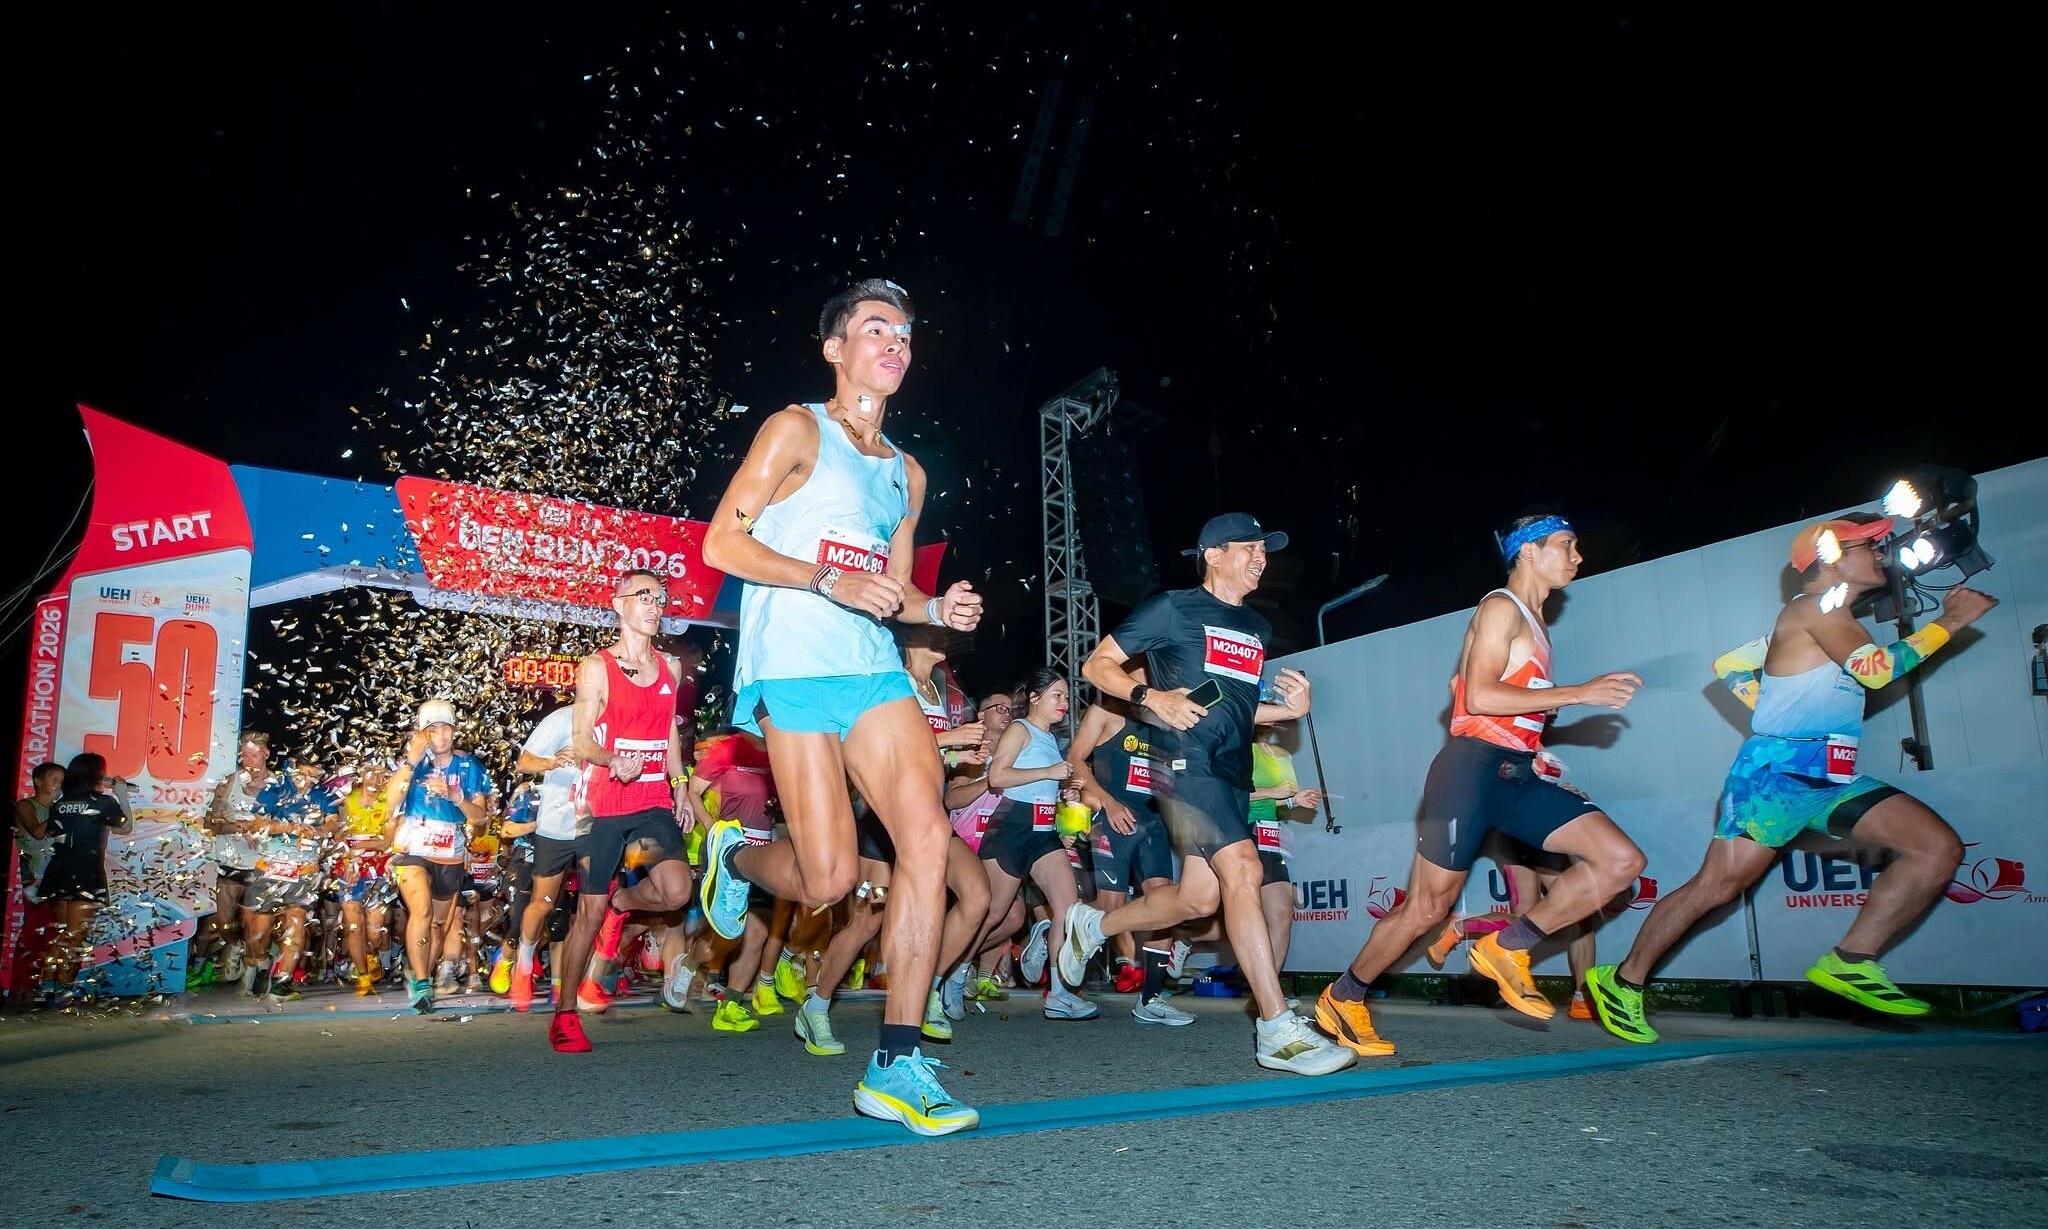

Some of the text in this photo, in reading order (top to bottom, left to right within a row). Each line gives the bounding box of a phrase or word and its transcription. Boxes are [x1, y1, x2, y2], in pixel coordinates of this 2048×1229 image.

[111, 512, 211, 551] START
[459, 518, 524, 556] UEH
[534, 533, 604, 566] RUN
[613, 542, 686, 578] 2026
[100, 586, 131, 601] UEH
[186, 594, 205, 604] UEH
[185, 603, 206, 612] RUN
[39, 608, 62, 658] 2026
[1213, 639, 1257, 660] M20407
[83, 611, 218, 783] 50
[152, 785, 204, 805] 2026
[59, 804, 89, 814] CREW
[1291, 879, 1348, 910] UEH
[1292, 910, 1348, 921] UNIVERSITY
